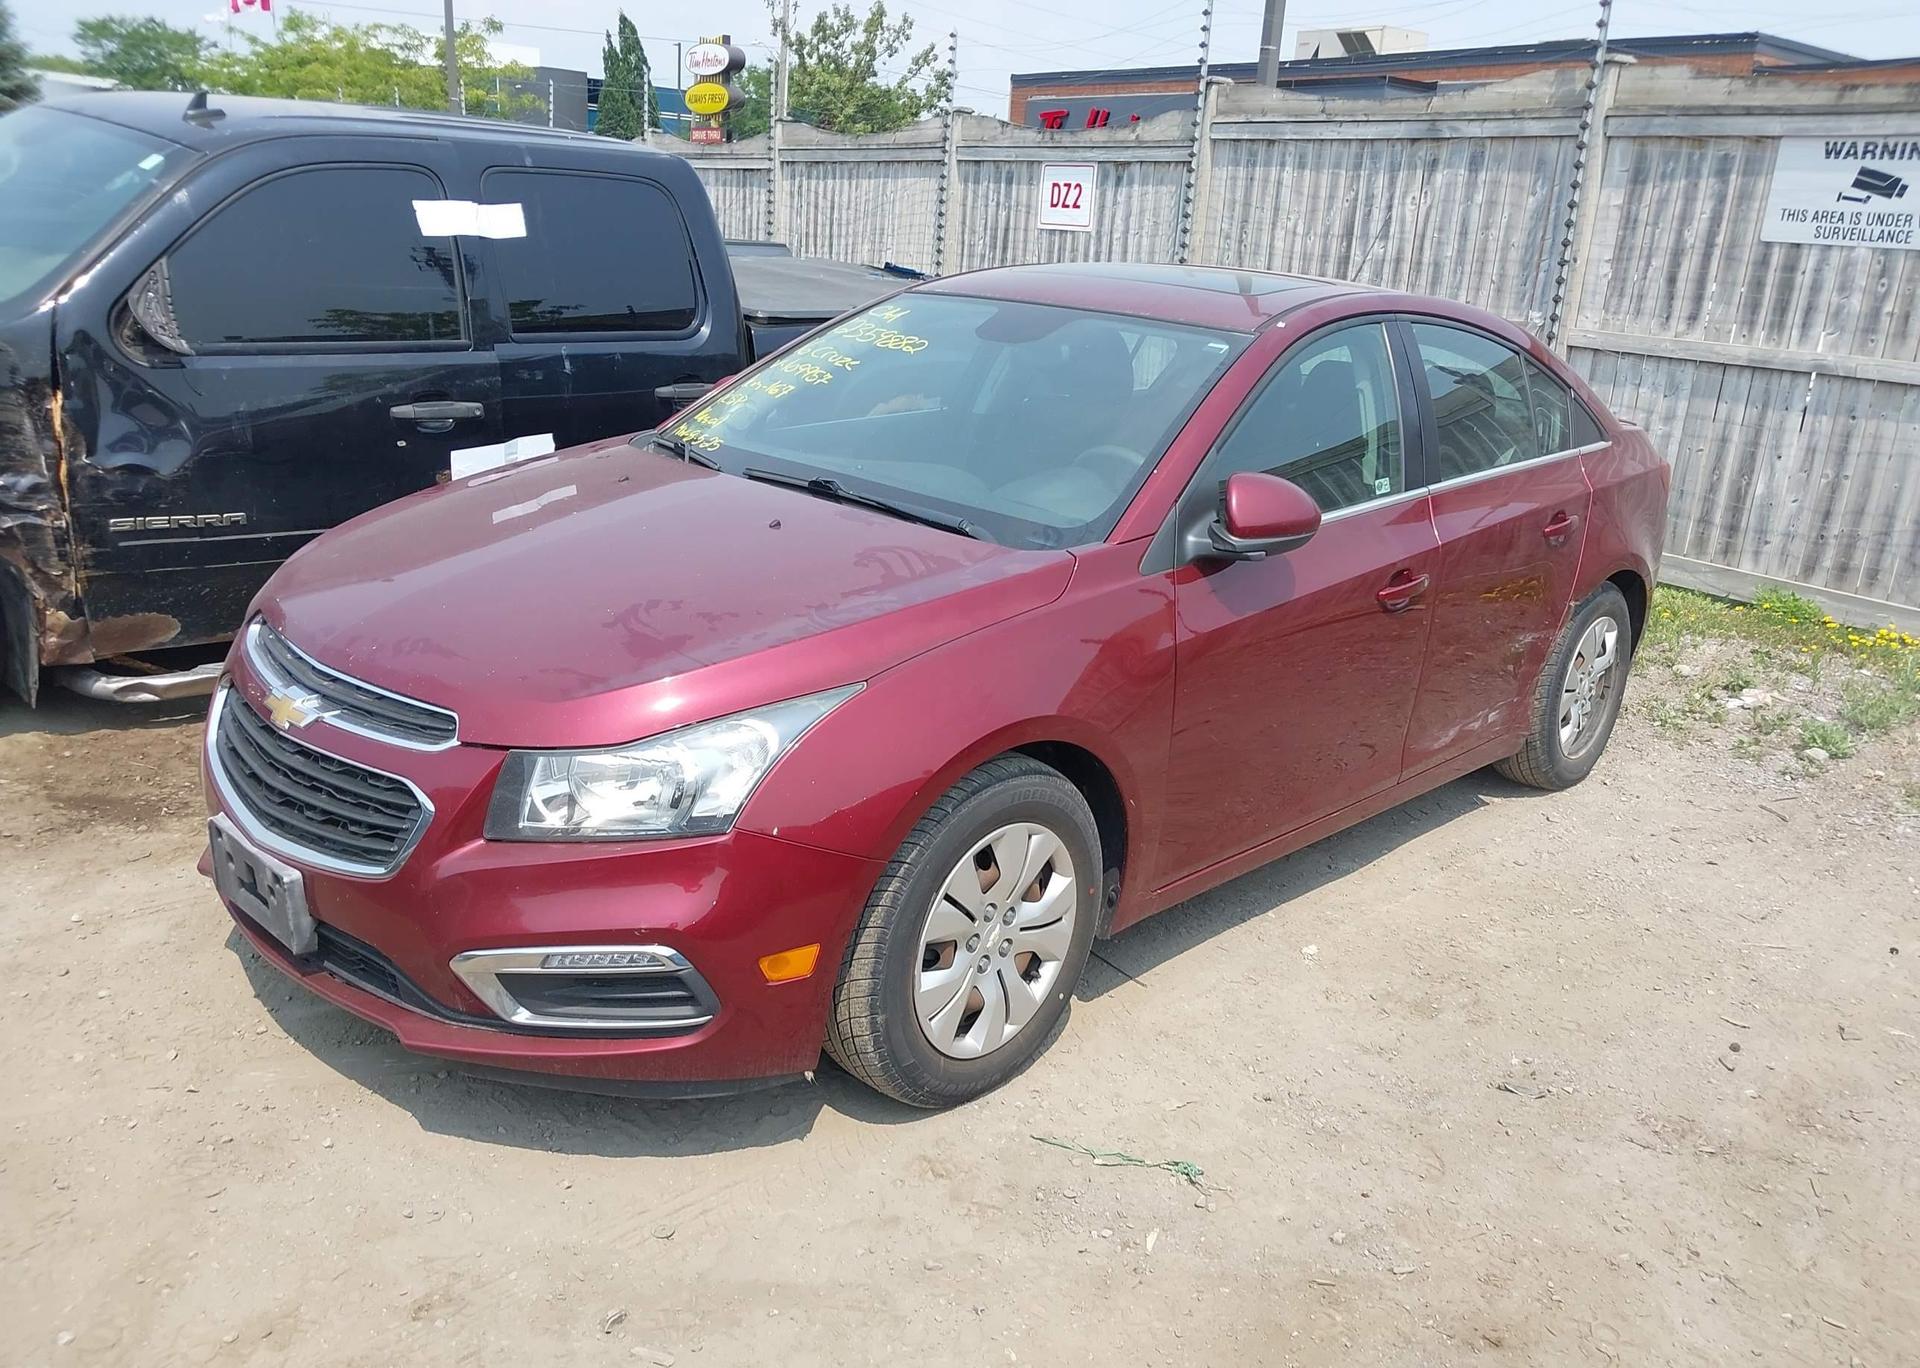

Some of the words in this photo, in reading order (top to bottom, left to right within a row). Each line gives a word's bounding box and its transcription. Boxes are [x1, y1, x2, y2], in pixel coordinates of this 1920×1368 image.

[689, 52, 701, 69] Tim
[702, 50, 726, 69] Hortons
[688, 93, 707, 104] ALWAYS
[707, 93, 726, 104] FRESH
[692, 130, 706, 140] DRIVE
[707, 130, 721, 140] THRU
[1824, 141, 1920, 160] WARNIN
[1050, 182, 1082, 209] DZ2
[1780, 208, 1808, 223] THIS
[1811, 210, 1845, 225] AREA
[1849, 211, 1863, 226] IS
[1866, 213, 1913, 228] UNDER
[1814, 225, 1914, 244] SURVEILLANCE
[109, 512, 248, 532] SIERRA
